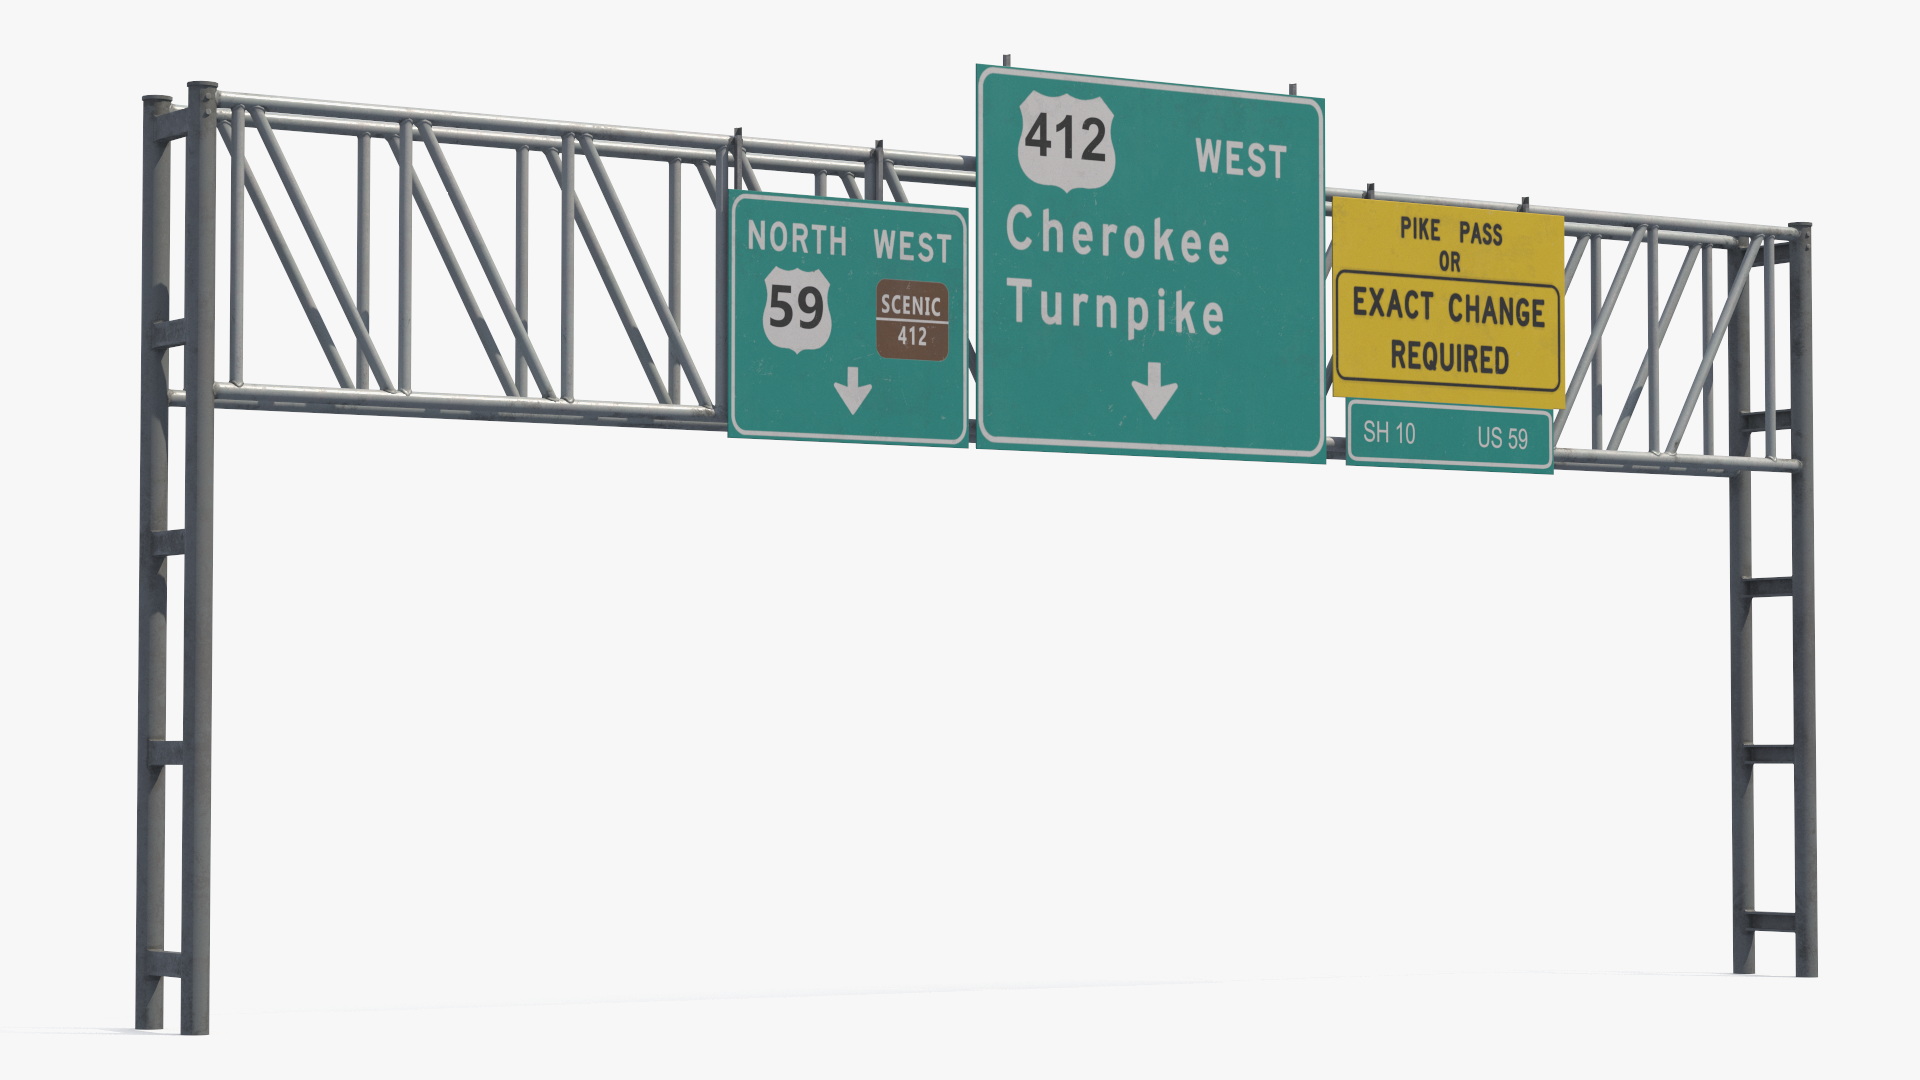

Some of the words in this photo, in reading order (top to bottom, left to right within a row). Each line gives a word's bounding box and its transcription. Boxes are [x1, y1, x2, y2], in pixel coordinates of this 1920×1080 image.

[1024, 111, 1106, 162] 412
[1195, 137, 1287, 179] WEST
[748, 219, 847, 256] NORTH
[873, 228, 952, 263] WEST
[1006, 203, 1229, 265] Cherokee
[1400, 216, 1441, 241] PIKE
[1459, 221, 1503, 246] PASS
[1439, 250, 1461, 273] OR
[769, 284, 824, 329] 59
[881, 293, 941, 316] SCENIC
[1006, 277, 1224, 341] Turnpike
[1353, 286, 1434, 320] EXACT
[1448, 293, 1545, 328] CHANGE
[897, 326, 927, 346] 412
[1391, 339, 1509, 375] REQUIRED
[1363, 419, 1389, 443] SH
[1396, 421, 1416, 445] 10
[1478, 425, 1503, 449] US
[1508, 428, 1528, 450] 59
